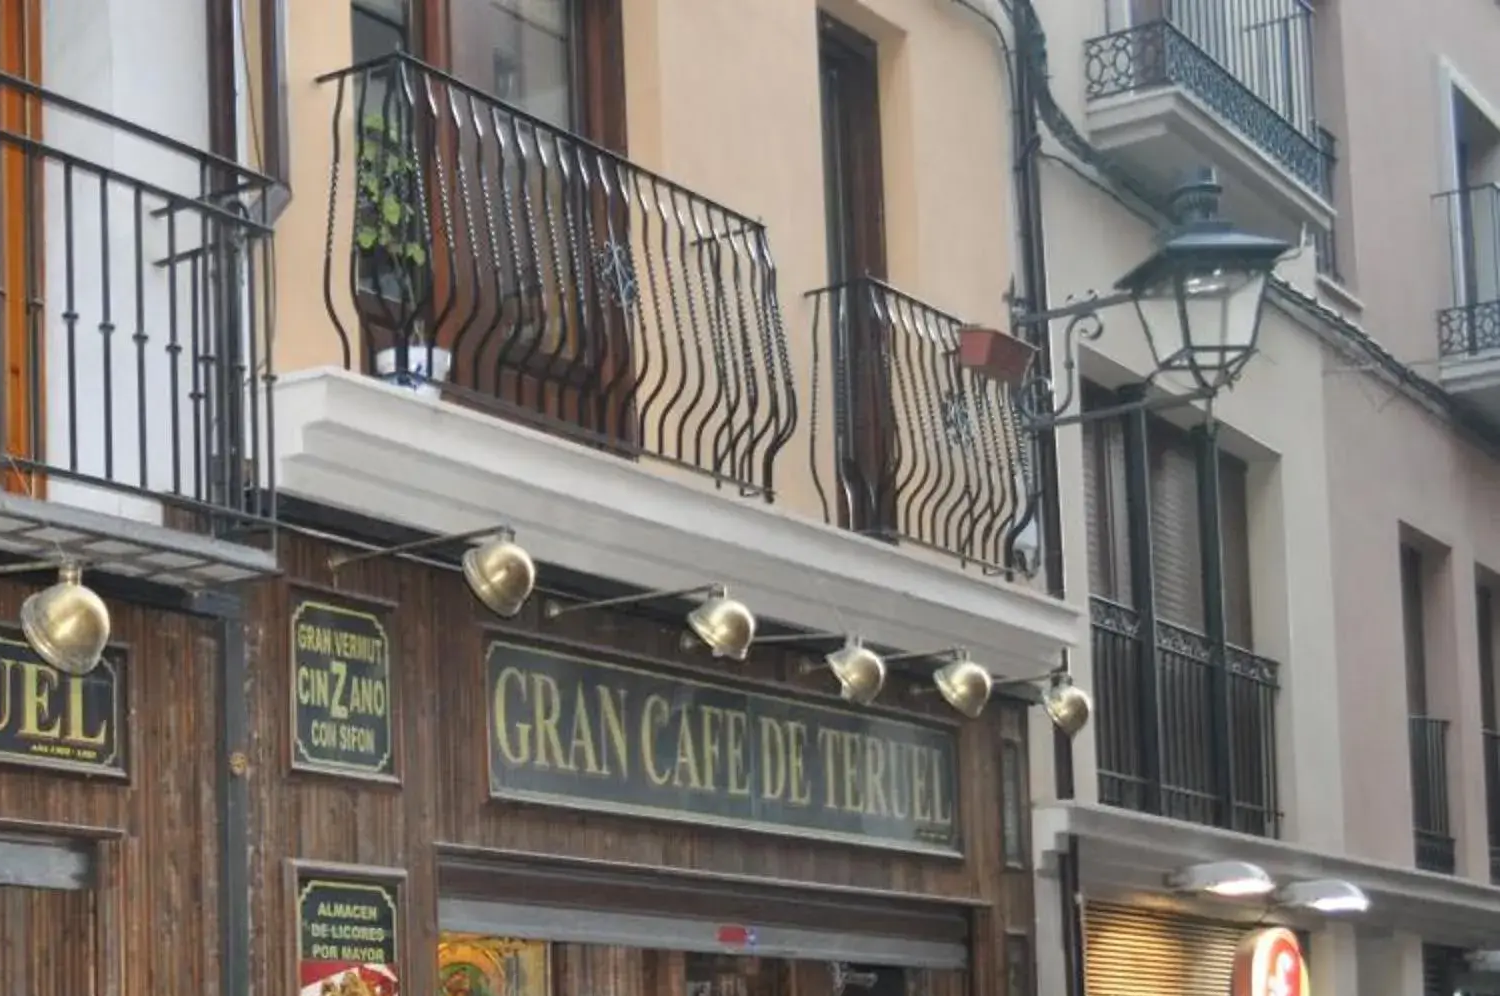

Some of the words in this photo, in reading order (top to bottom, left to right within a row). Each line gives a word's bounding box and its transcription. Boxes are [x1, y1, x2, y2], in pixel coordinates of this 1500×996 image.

[298, 624, 331, 654] GRAN
[298, 661, 385, 718] CINZANO
[494, 667, 629, 779] GRAN
[640, 694, 752, 796] CAFE
[760, 716, 812, 807] DE
[817, 727, 953, 826] TERUEL
[311, 923, 328, 938] DE
[312, 944, 338, 960] POR
